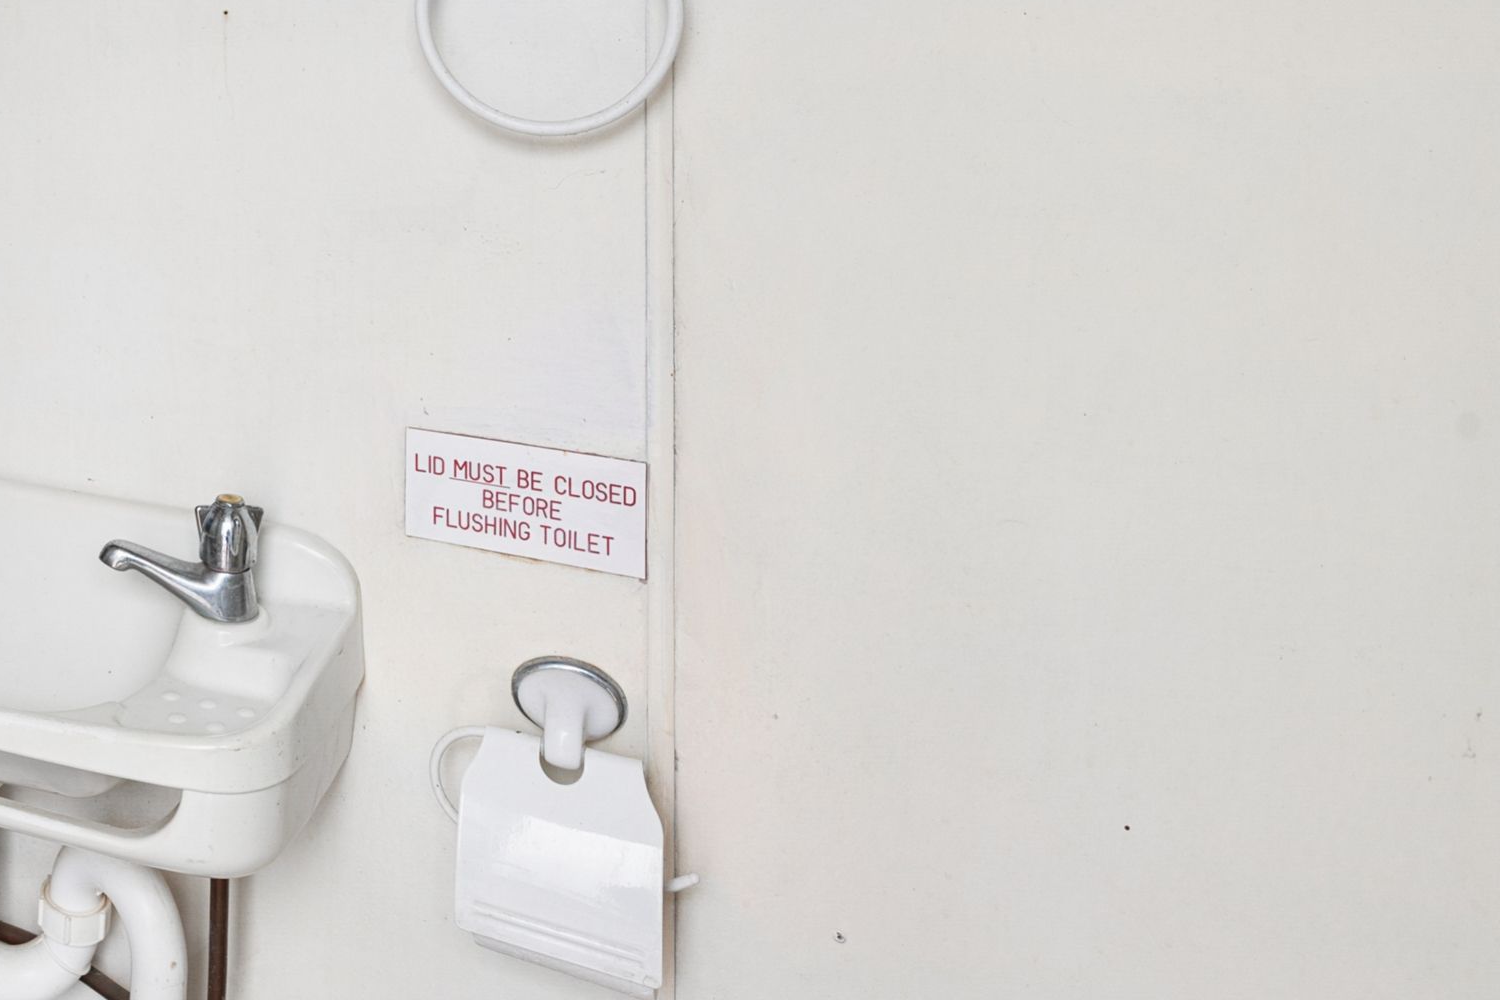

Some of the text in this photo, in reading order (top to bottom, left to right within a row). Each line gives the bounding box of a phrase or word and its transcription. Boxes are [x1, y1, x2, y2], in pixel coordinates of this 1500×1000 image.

[414, 453, 636, 506] LID MUST BE CLOSED
[482, 490, 562, 520] BEFORE
[433, 506, 614, 556] FLUSHING TOILET
